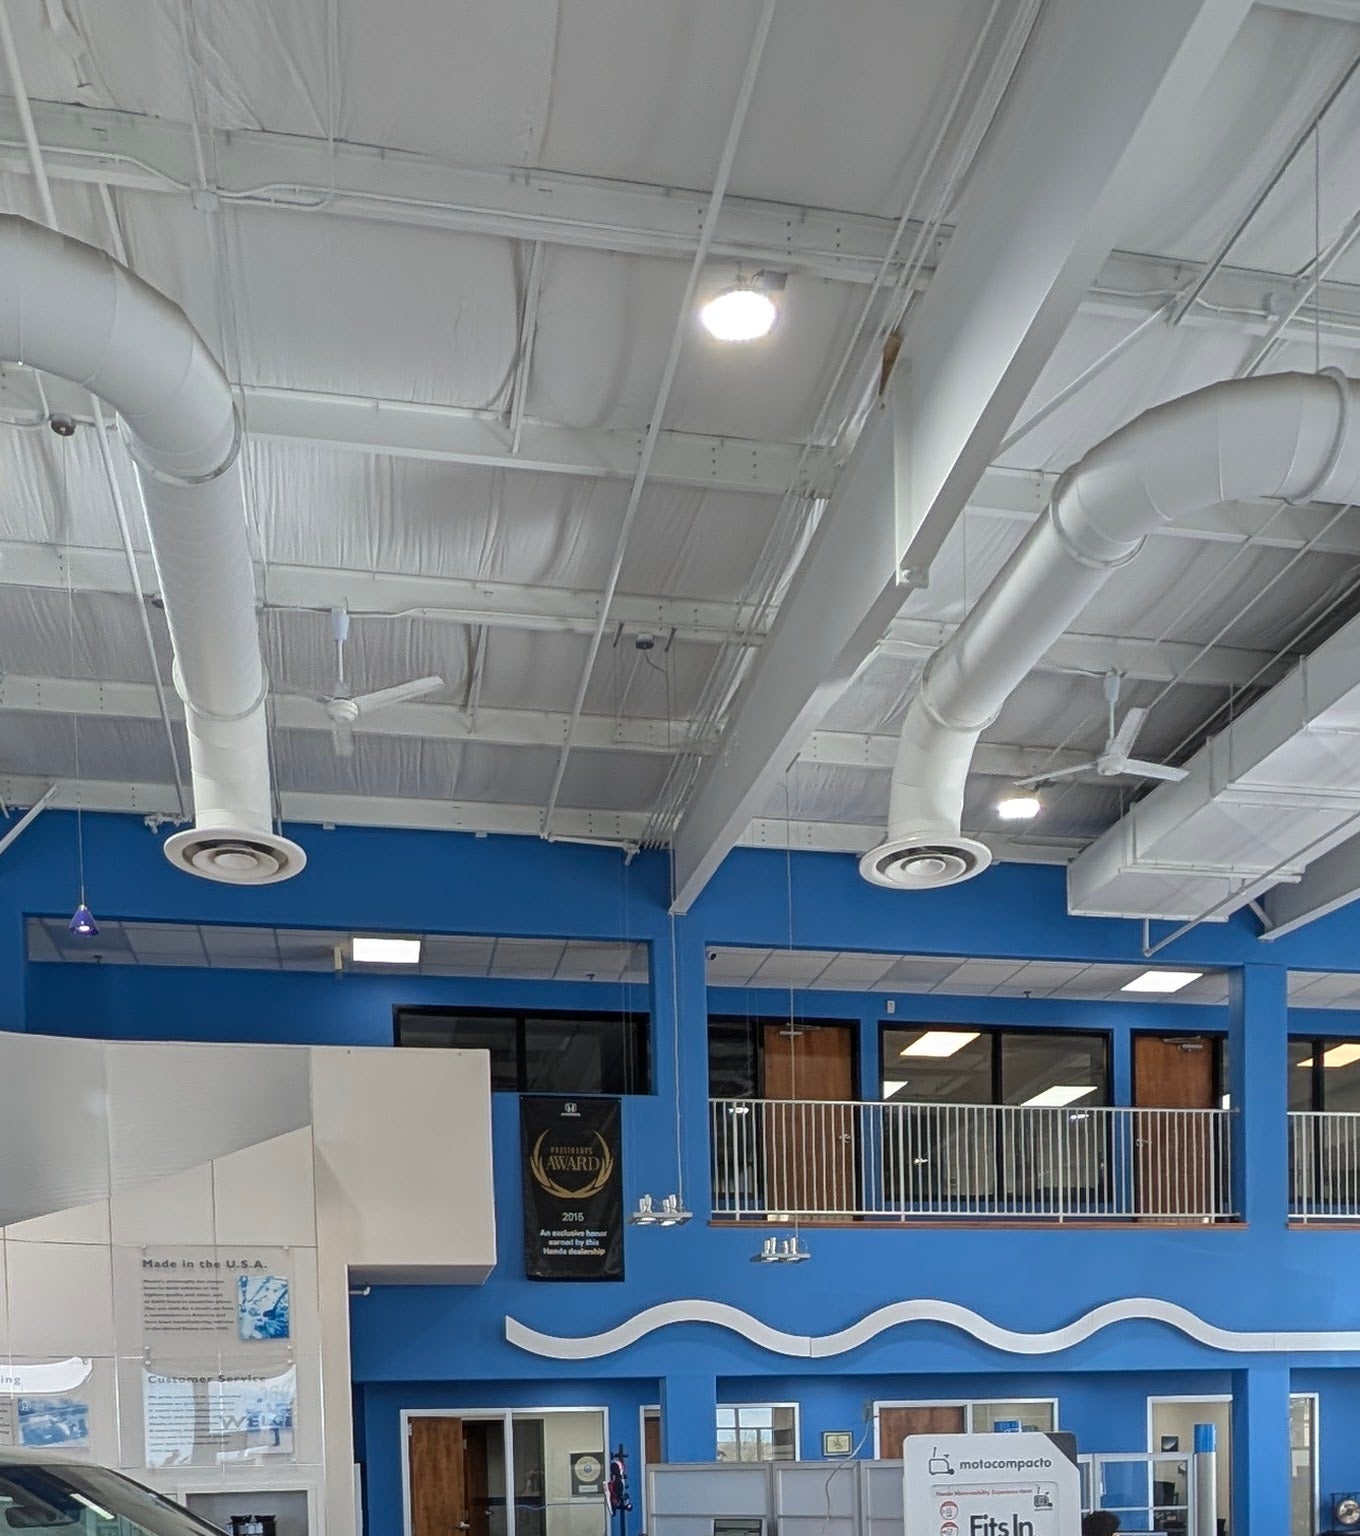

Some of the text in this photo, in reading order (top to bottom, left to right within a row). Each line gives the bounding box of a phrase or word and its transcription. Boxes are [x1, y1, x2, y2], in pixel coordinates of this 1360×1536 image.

[546, 1155, 601, 1171] AWARD
[540, 1229, 551, 1237] An
[142, 1259, 268, 1269] Made in the U.S.A.
[148, 1374, 267, 1385] Customer Service
[960, 1458, 1052, 1472] motocompacto
